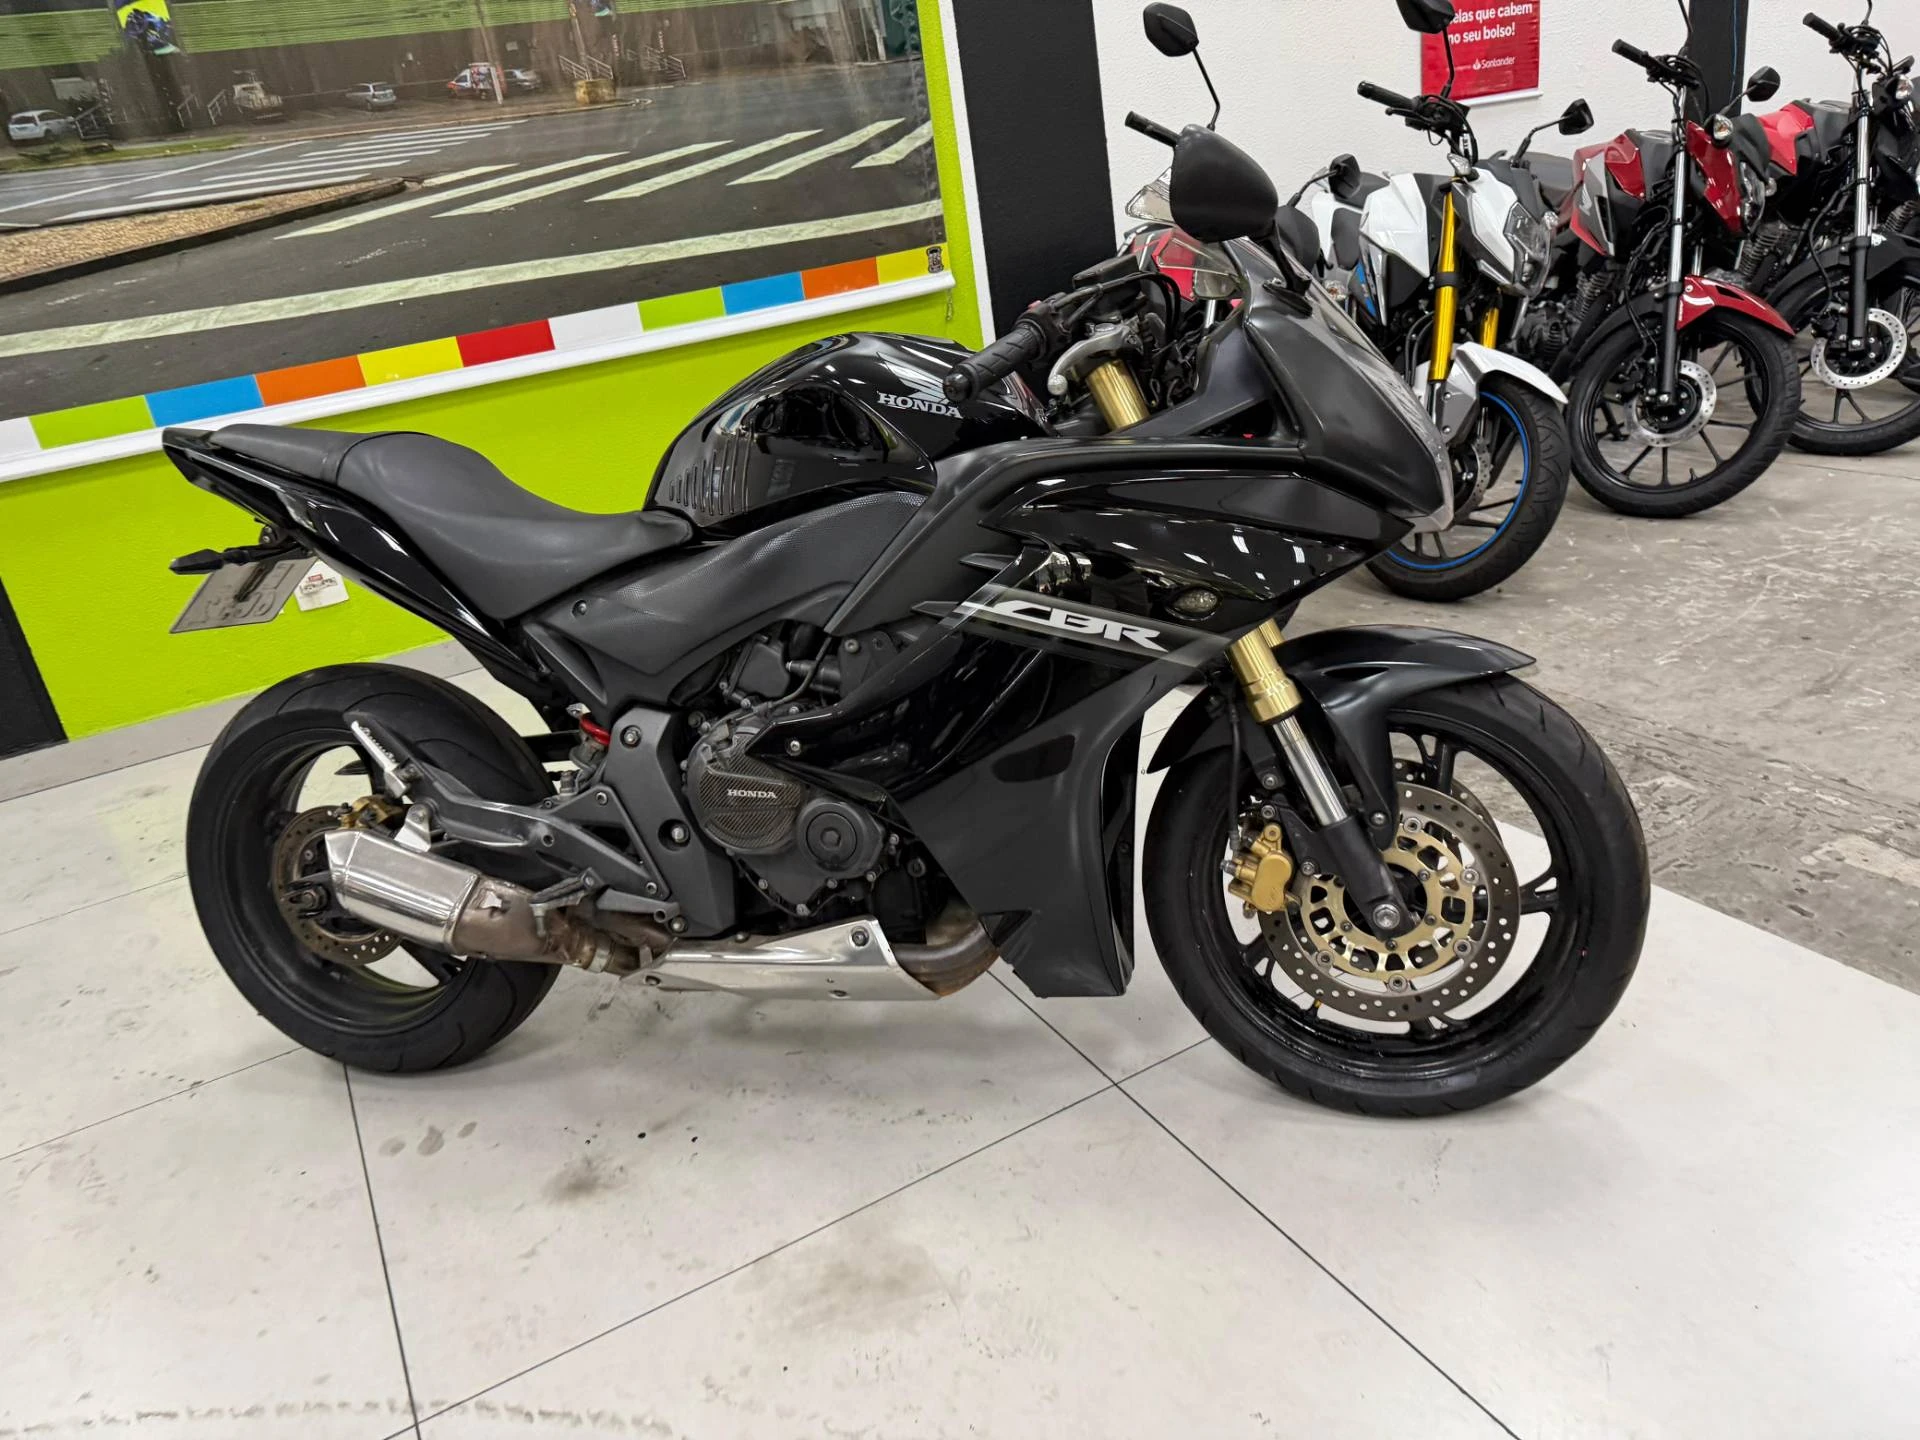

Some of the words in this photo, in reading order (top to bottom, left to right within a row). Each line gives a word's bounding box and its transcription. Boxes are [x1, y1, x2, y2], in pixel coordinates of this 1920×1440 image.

[1450, 8, 1474, 24] elas
[1475, 8, 1496, 24] que
[1497, 2, 1533, 18] cabem
[1447, 33, 1461, 45] no
[1462, 30, 1482, 43] seu
[1483, 22, 1516, 40] bolso!
[1480, 56, 1516, 70] Santander
[876, 391, 964, 419] HONDA
[953, 599, 1169, 653] CBR
[726, 788, 778, 799] HONDA
